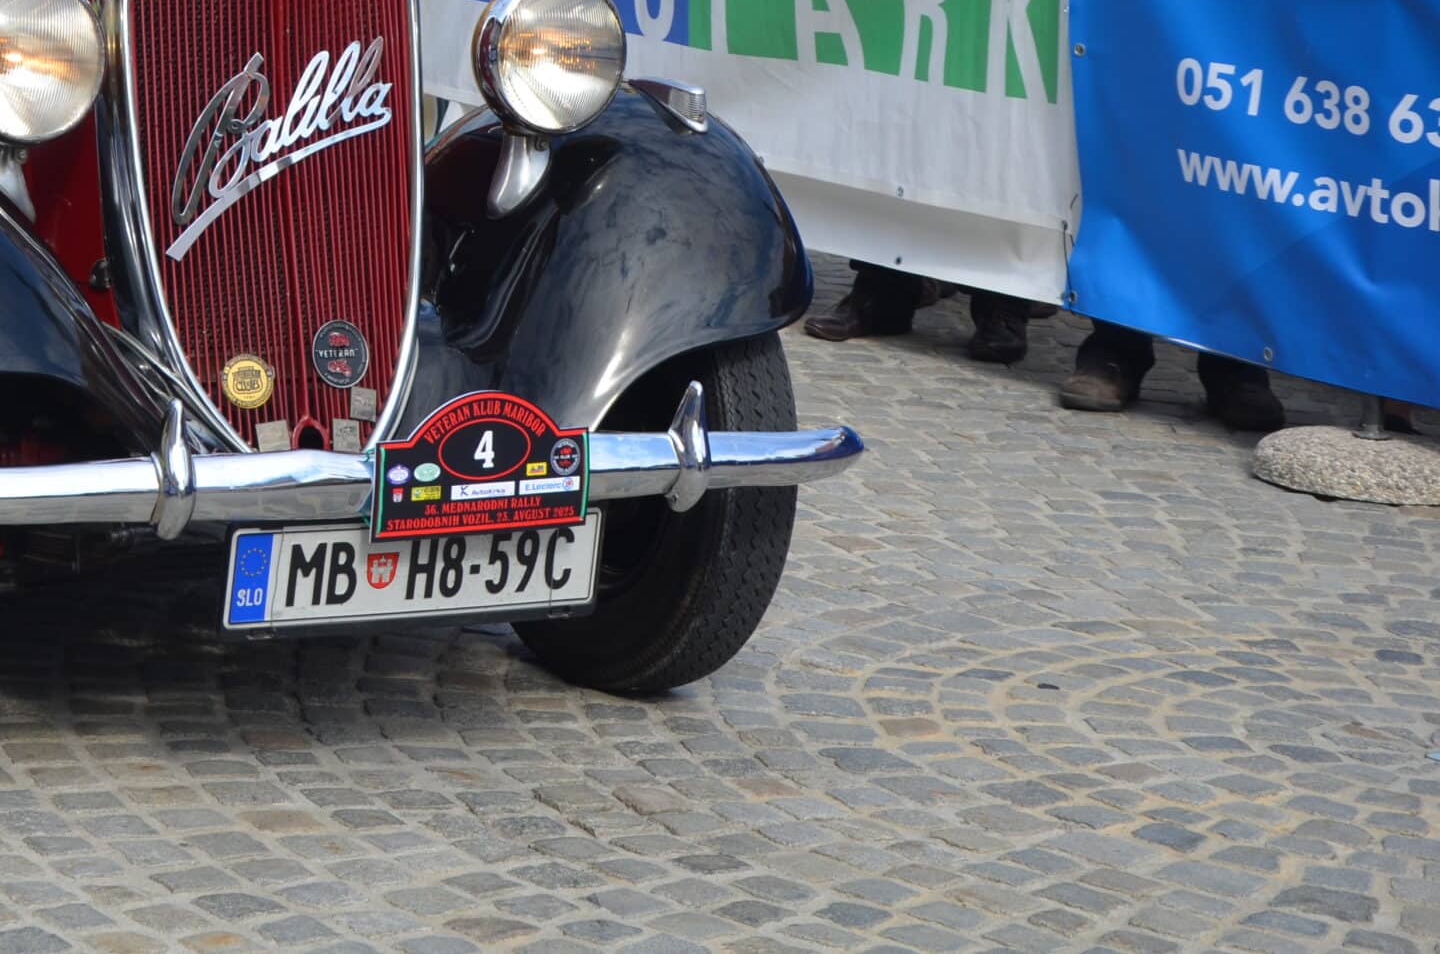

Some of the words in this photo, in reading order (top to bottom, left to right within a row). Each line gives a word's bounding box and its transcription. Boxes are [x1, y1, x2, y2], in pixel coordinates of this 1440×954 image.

[1176, 57, 1264, 117] 051
[1284, 76, 1371, 136] 638
[171, 35, 393, 236] Balilla
[423, 407, 471, 445] VETERAN
[472, 400, 501, 417] KLUB
[503, 400, 547, 438] MARIBOR
[473, 430, 496, 469] 4
[387, 514, 460, 531] STARODOBNIH
[512, 506, 550, 521] AVGUST
[441, 499, 508, 515] MEDNARODNI
[510, 496, 543, 509] RALLY
[285, 541, 358, 608] MB
[404, 528, 576, 601] H8-59C
[235, 588, 263, 608] SLO
